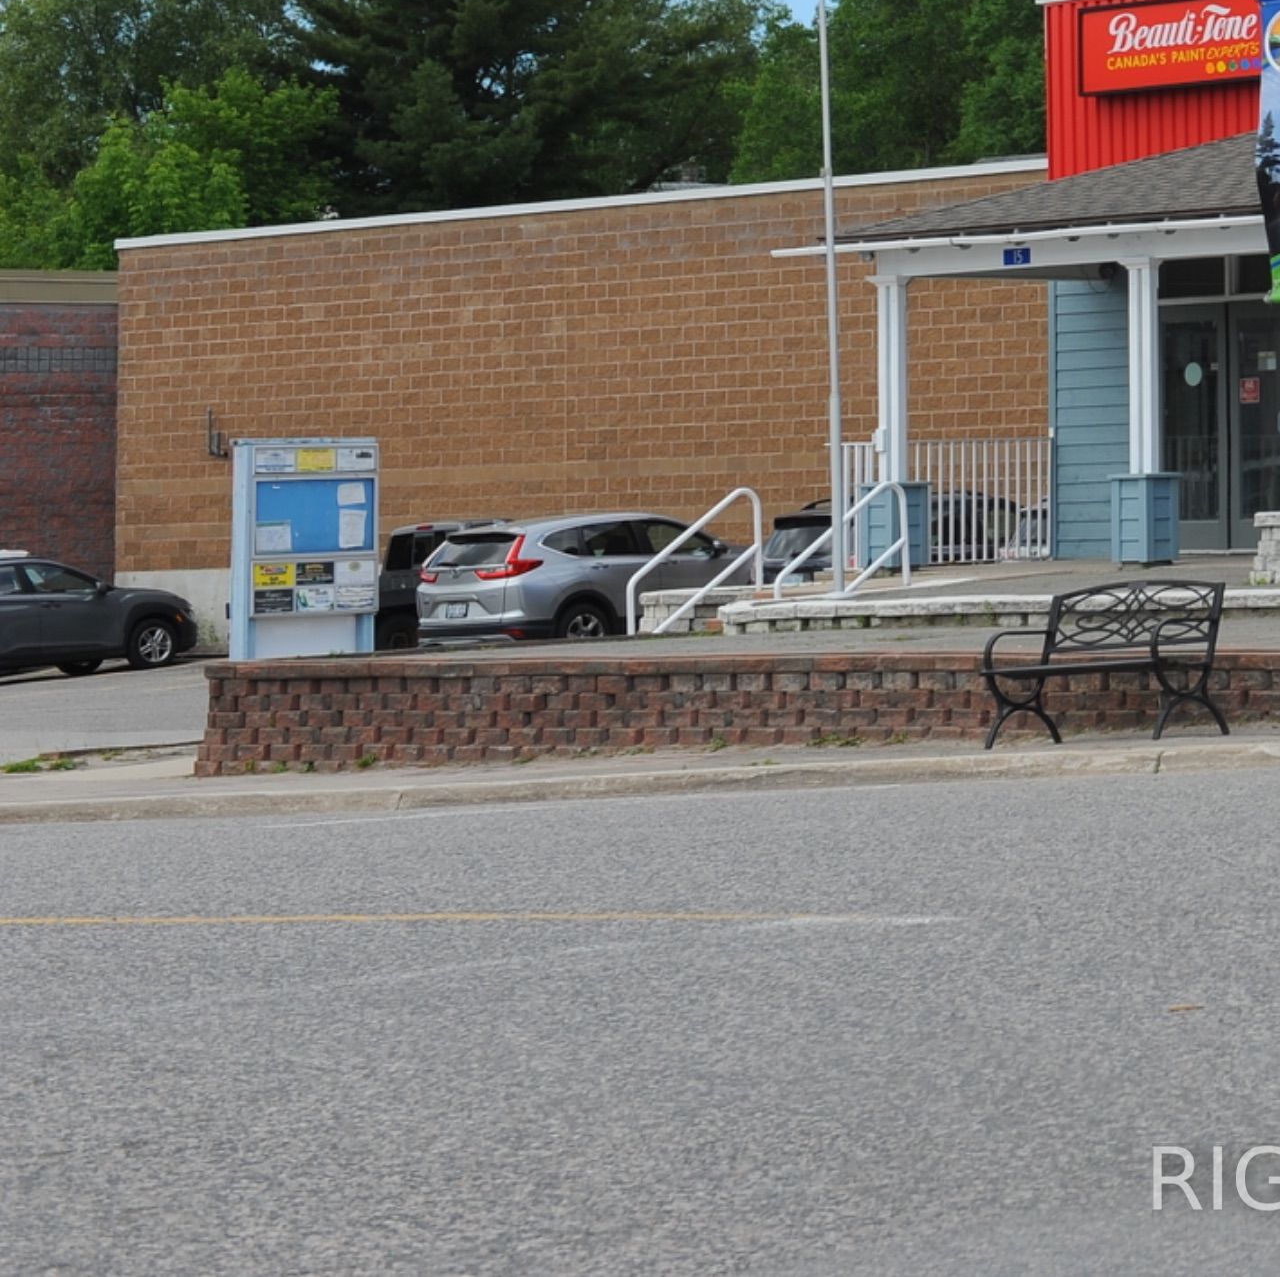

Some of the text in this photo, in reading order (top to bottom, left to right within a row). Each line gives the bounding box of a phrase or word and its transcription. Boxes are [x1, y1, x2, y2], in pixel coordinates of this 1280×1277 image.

[1106, 42, 1260, 71] CANADA'S PAINT EXPERTS
